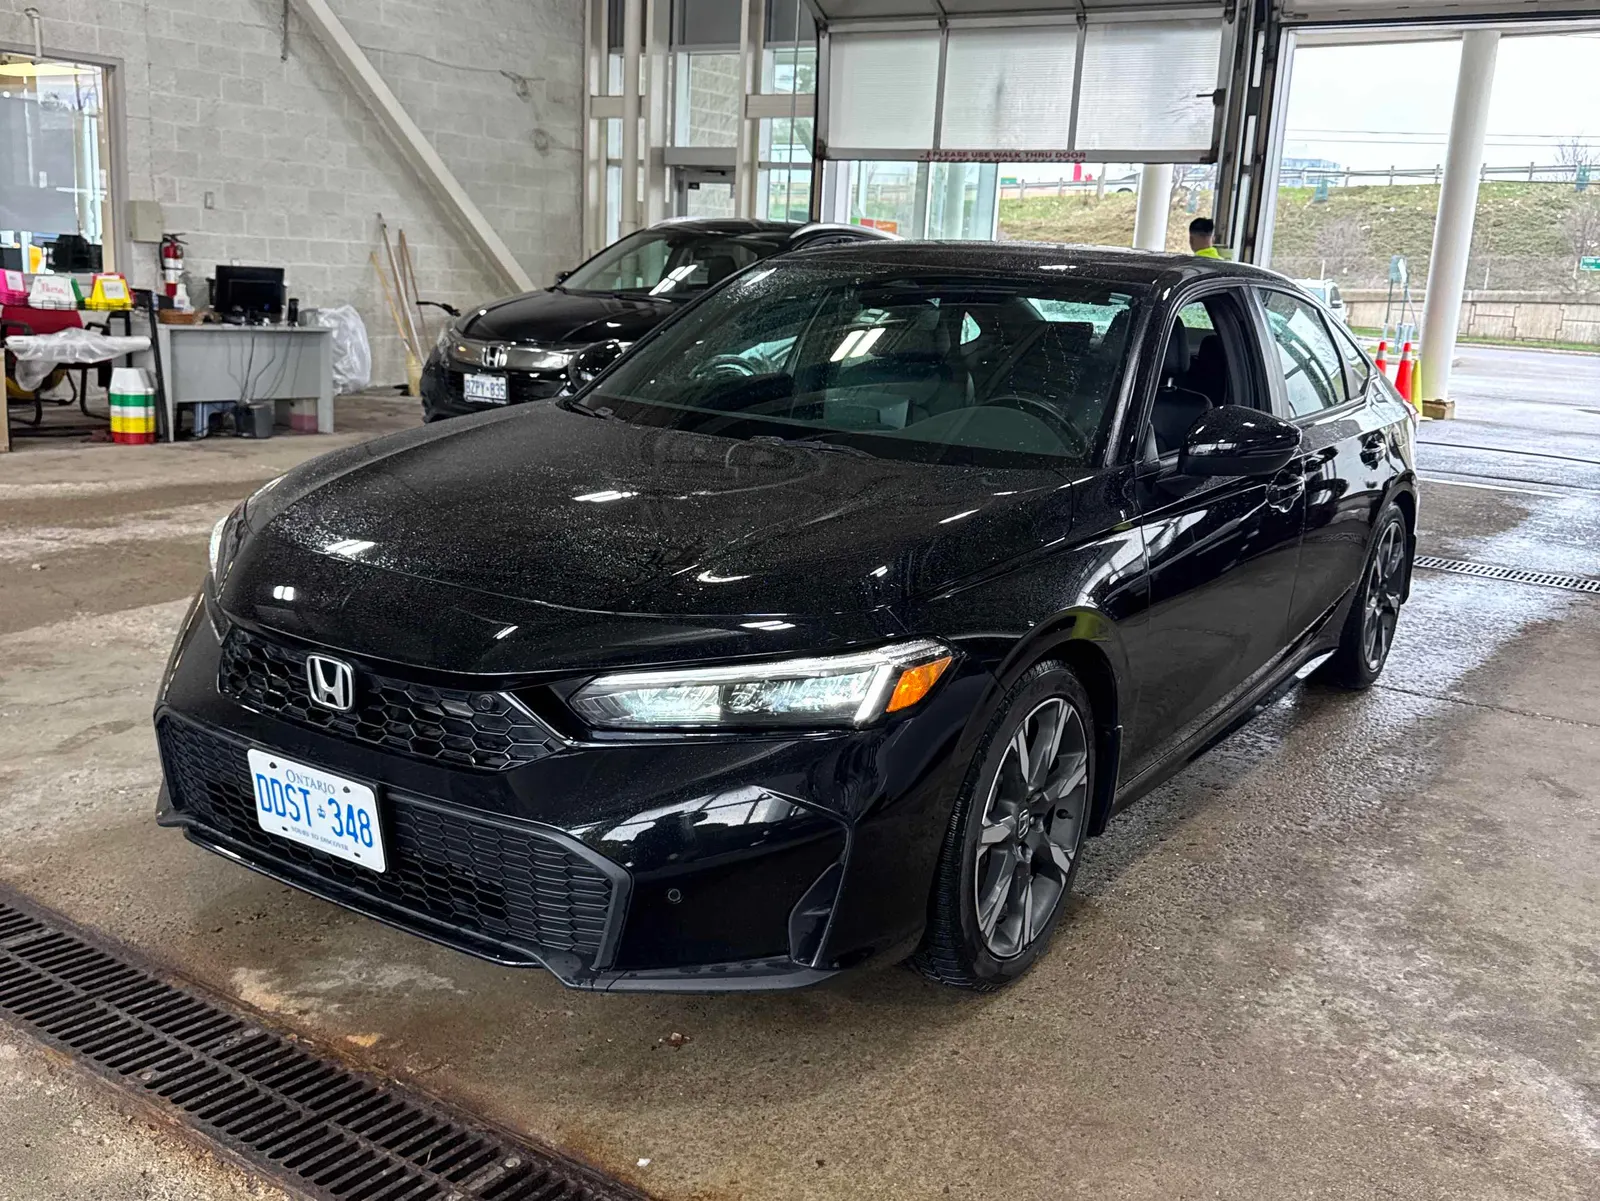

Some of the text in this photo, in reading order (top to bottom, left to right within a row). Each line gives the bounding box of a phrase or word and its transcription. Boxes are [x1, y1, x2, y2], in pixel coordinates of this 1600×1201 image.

[932, 150, 1086, 159] PLEASE USE WALK THRU DOOR
[286, 769, 335, 795] ONTARIO
[256, 773, 373, 848] DDST 348
